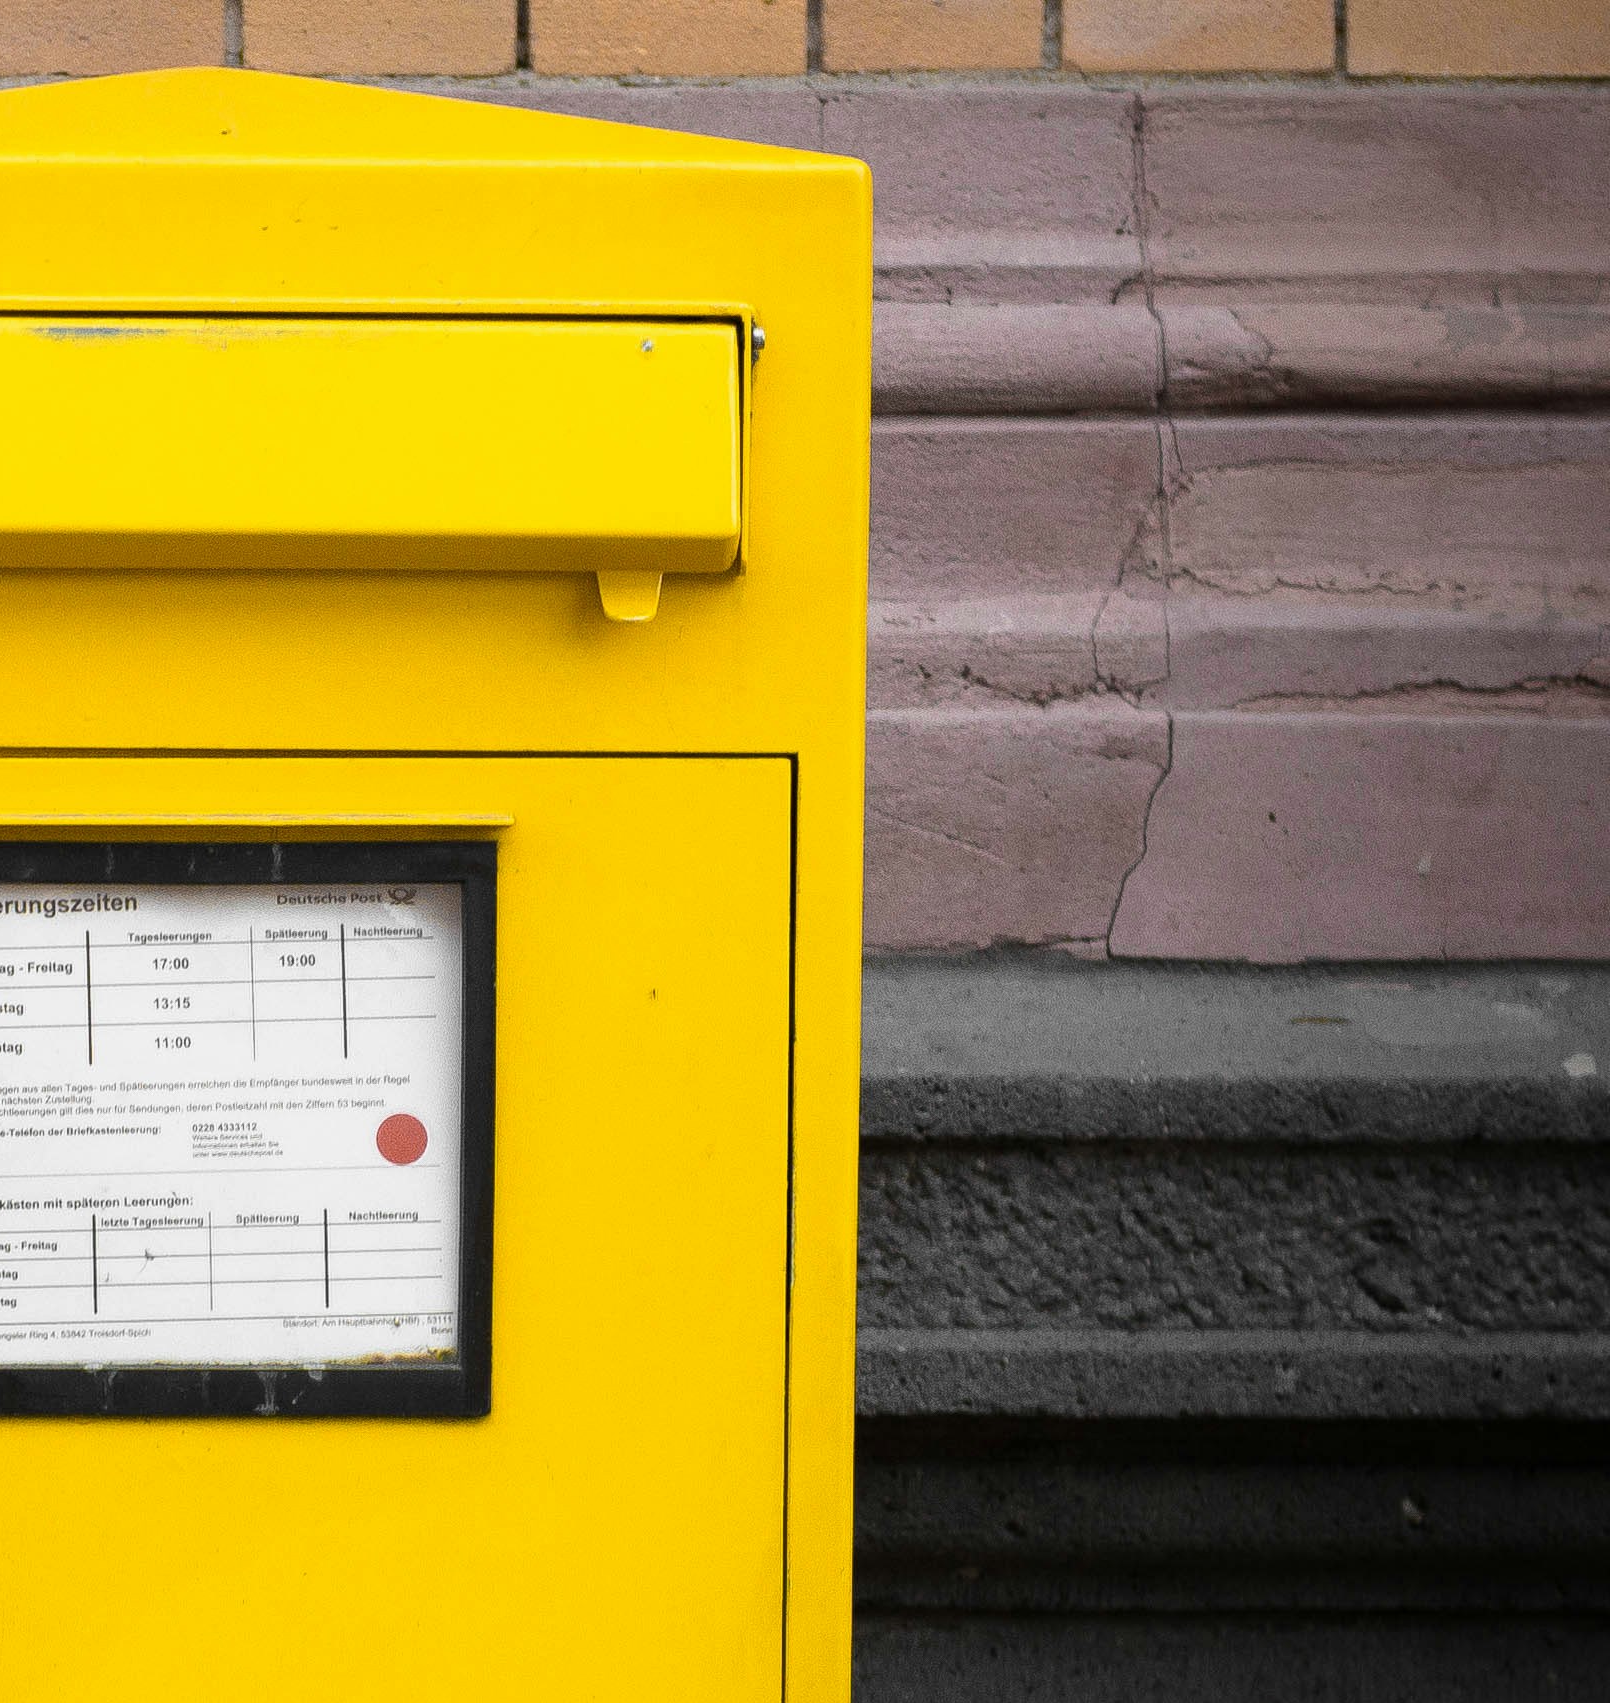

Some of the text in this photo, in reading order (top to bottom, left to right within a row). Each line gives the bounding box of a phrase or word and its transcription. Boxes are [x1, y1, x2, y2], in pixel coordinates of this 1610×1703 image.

[276, 892, 382, 905] Deutsche Post
[128, 932, 212, 943] Tagesleerungen
[265, 929, 327, 940] Spätleerung
[354, 927, 423, 937] Nachtleerung
[152, 958, 189, 970] 17:00
[279, 955, 315, 966] 19:00
[28, 962, 73, 974] Freitag
[153, 998, 190, 1010] 13:15
[155, 1037, 191, 1048] 11:00
[41, 1084, 62, 1092] allen
[67, 1084, 97, 1093] Tages-
[100, 1083, 116, 1092] und
[120, 1081, 185, 1092] Spätleerungen
[188, 1080, 230, 1089] erreichen
[233, 1079, 246, 1087] die
[250, 1078, 299, 1089] Empfänger
[302, 1077, 352, 1086] bundesweit
[355, 1077, 363, 1085] in
[366, 1076, 381, 1085] der
[384, 1075, 410, 1085] Regel
[2, 1096, 42, 1105] nächsten
[60, 1107, 72, 1116] gilt
[76, 1106, 94, 1115] dies
[115, 1105, 126, 1114] für
[187, 1104, 212, 1112] deren
[216, 1102, 267, 1111] Postleitzahl
[270, 1101, 283, 1110] mit
[286, 1101, 303, 1109] den
[306, 1100, 334, 1109] Ziffern
[338, 1099, 348, 1108] 53
[48, 1128, 63, 1136] der
[67, 1126, 161, 1137] Briefkastenleerung:
[192, 1124, 215, 1132] 0228
[217, 1123, 257, 1131] 4333112
[44, 1199, 62, 1209] mit
[67, 1198, 119, 1210] späteren
[124, 1196, 193, 1208] Leerungen:
[101, 1217, 204, 1227] letzte Tagesleerung
[236, 1214, 299, 1224] Spätleerung
[349, 1211, 418, 1222] Nachtleerung
[21, 1242, 57, 1251] Freitag
